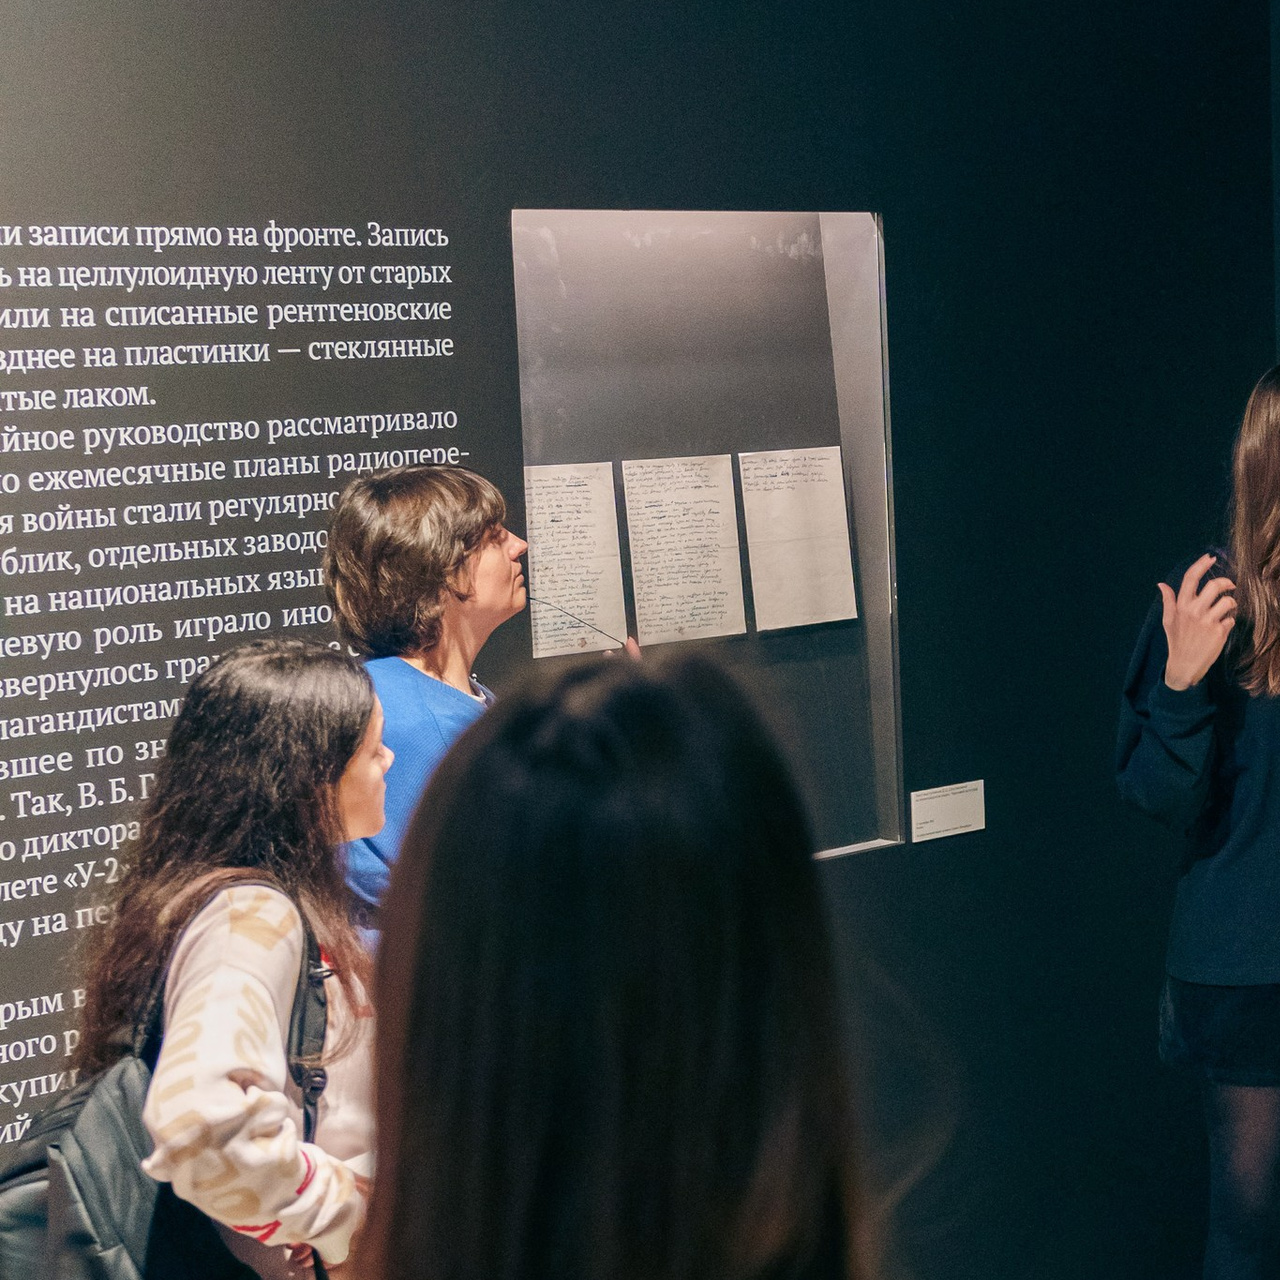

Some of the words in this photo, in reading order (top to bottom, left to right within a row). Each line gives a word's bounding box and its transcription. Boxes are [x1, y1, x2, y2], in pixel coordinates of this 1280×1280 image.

[0, 226, 23, 245] и
[29, 226, 130, 246] записи
[135, 227, 222, 252] прямо
[227, 227, 259, 246] на
[264, 220, 362, 252] фронте.
[367, 222, 449, 246] Запись
[17, 267, 53, 287] на
[58, 266, 258, 292] целлулоидную
[262, 266, 334, 290] ленту
[338, 266, 365, 284] от
[370, 266, 452, 289] старых
[60, 307, 96, 327] на
[105, 305, 258, 326] списанные
[266, 302, 451, 329] рентгеновские
[83, 347, 118, 367] на
[124, 344, 270, 366] пластинки
[308, 338, 453, 360] стеклянные
[0, 390, 56, 411] тые
[62, 387, 156, 409] лаком.
[1, 426, 74, 452] йное
[83, 421, 260, 454] руководство
[267, 411, 457, 444] рассматривало
[28, 461, 225, 491] ежемесячные
[233, 456, 320, 478] планы
[328, 446, 470, 479] радиопере-
[21, 504, 117, 533] войны
[124, 502, 202, 525] стали
[1, 547, 81, 575] блик,
[88, 538, 238, 570] отдельных
[4, 594, 41, 616] на
[48, 574, 261, 611] национальных
[93, 623, 163, 654] роль
[174, 610, 271, 642] играло
[282, 604, 333, 628] ино
[0, 663, 158, 700] вернулось
[165, 654, 220, 684] гра
[0, 696, 186, 742] агандистам
[85, 745, 123, 768] по
[10, 791, 72, 818] Так,
[77, 782, 104, 809] В.
[109, 777, 134, 804] Б.
[22, 821, 140, 863] диктора
[31, 913, 69, 936] на
